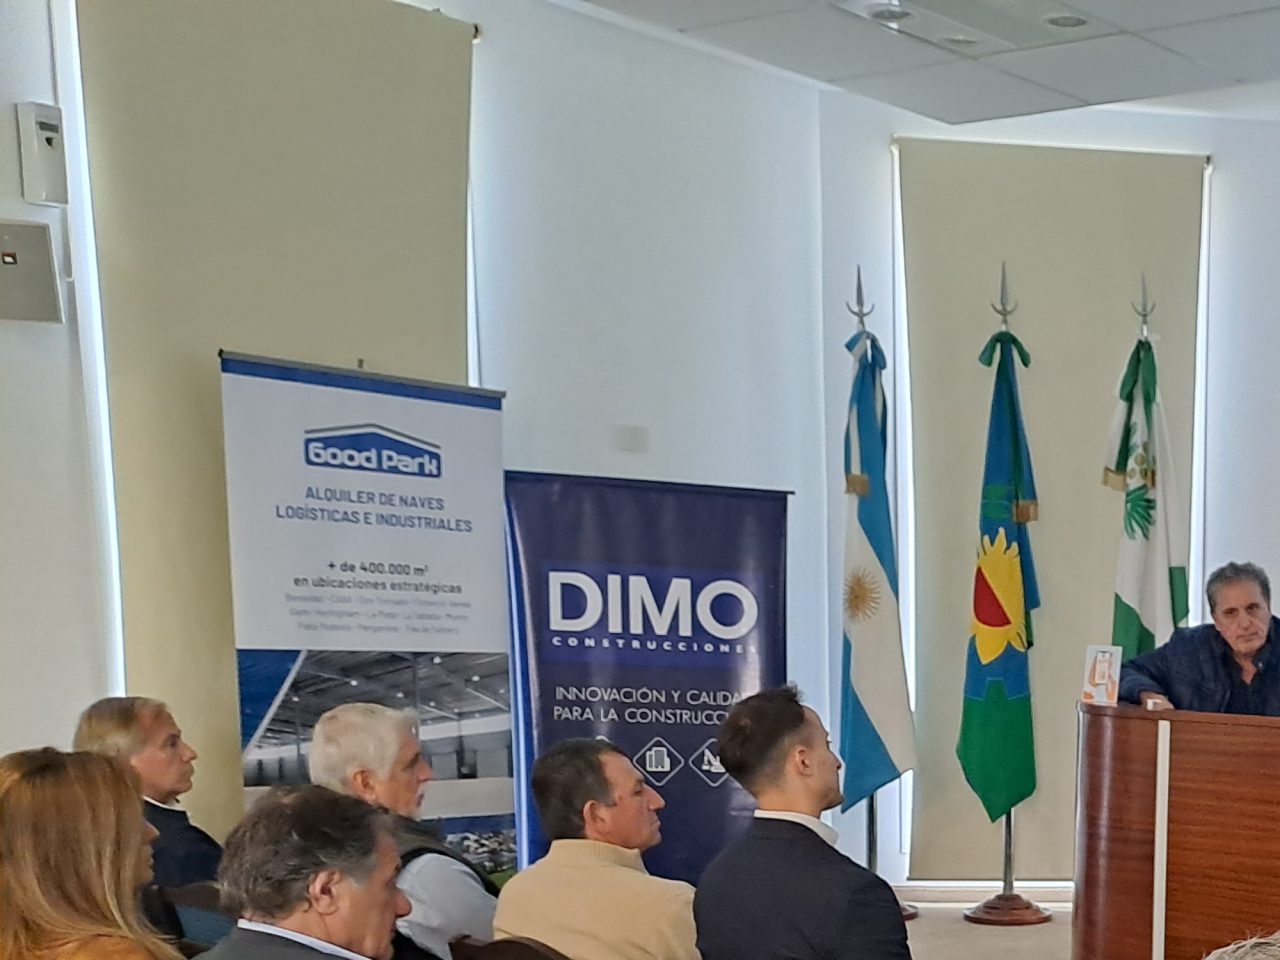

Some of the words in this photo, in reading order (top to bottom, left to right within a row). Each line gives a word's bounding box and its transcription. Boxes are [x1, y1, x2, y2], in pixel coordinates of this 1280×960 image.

[308, 441, 377, 470] Good
[382, 449, 438, 475] Park
[305, 485, 376, 505] ALQUILER
[379, 492, 395, 507] DE
[399, 495, 445, 511] NAVES
[275, 504, 360, 525] LOGÍSTICAS
[364, 511, 373, 525] E
[376, 512, 473, 533] INDUSTRIALES
[339, 560, 356, 573] de
[359, 561, 411, 576] 400.000
[293, 577, 309, 588] en
[311, 576, 387, 591] ubicaciones
[548, 570, 759, 640] DIMO
[555, 685, 666, 704] INNOVACIÓN
[671, 690, 680, 703] Y
[686, 689, 745, 706] CALIDA
[553, 705, 594, 721] PARA
[600, 707, 619, 722] LA
